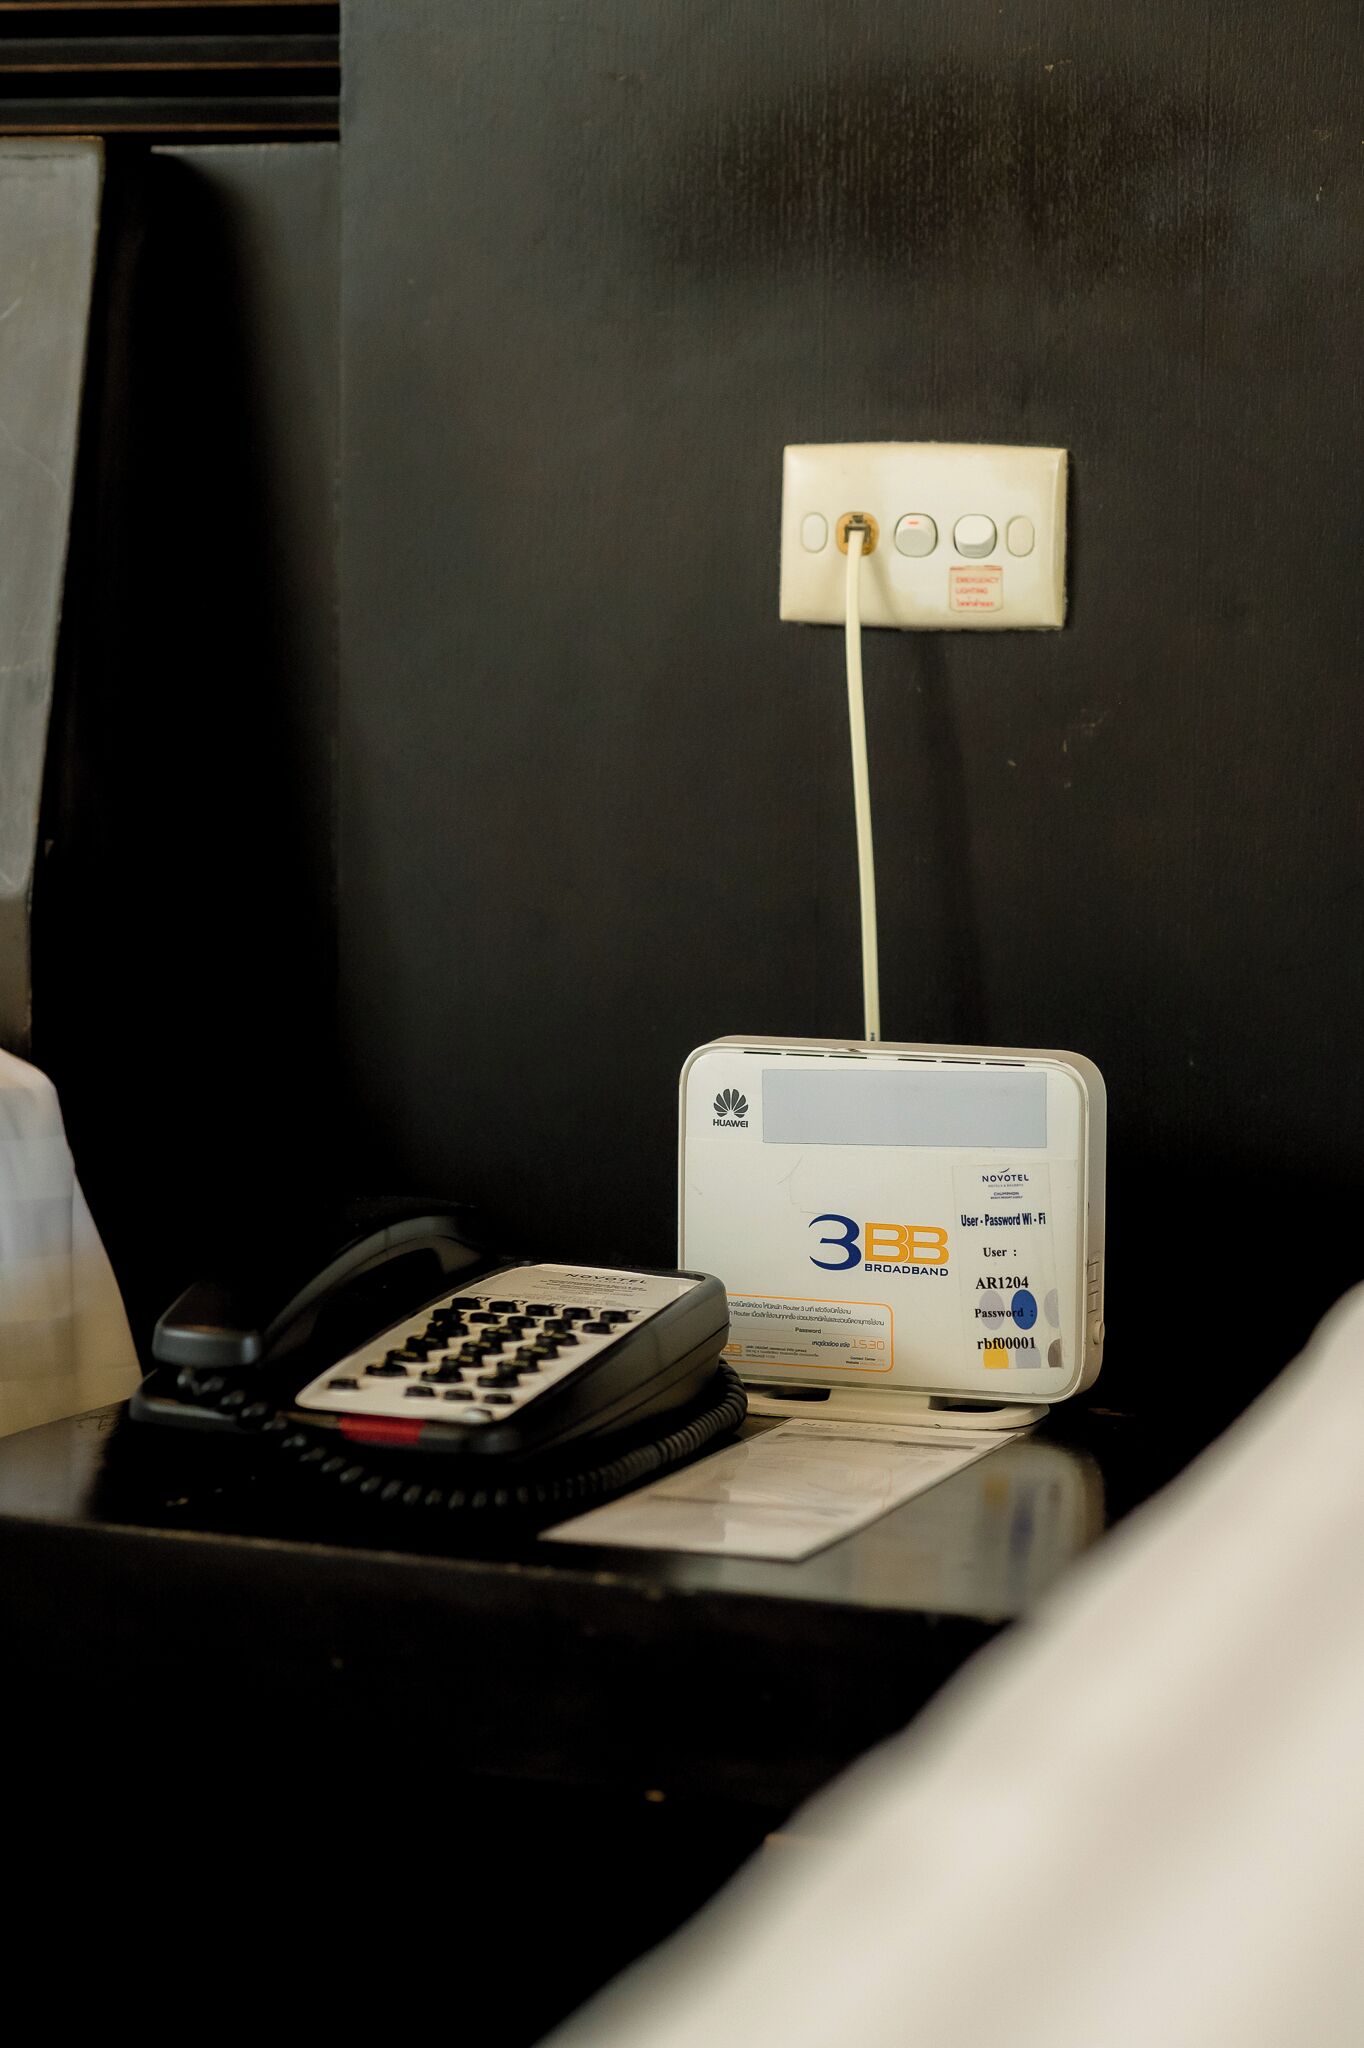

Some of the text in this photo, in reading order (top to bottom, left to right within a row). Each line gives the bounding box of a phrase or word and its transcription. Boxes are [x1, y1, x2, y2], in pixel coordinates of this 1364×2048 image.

[712, 1118, 749, 1128] HUAWEI
[982, 1174, 1029, 1182] NOVOTEL
[961, 1214, 979, 1226] User
[985, 1213, 1021, 1226] Password
[1022, 1212, 1033, 1225] Wi
[1038, 1212, 1046, 1224] Fi
[808, 1213, 949, 1271] 3BB
[983, 1247, 1008, 1258] User
[864, 1263, 949, 1277] BROADBAND
[565, 1273, 647, 1284] NOVOTEL
[976, 1276, 1029, 1289] AR1204
[734, 1309, 751, 1317] Router
[975, 1307, 1024, 1319] Password
[851, 1339, 885, 1350] 1530
[977, 1337, 1036, 1350] rbf00001
